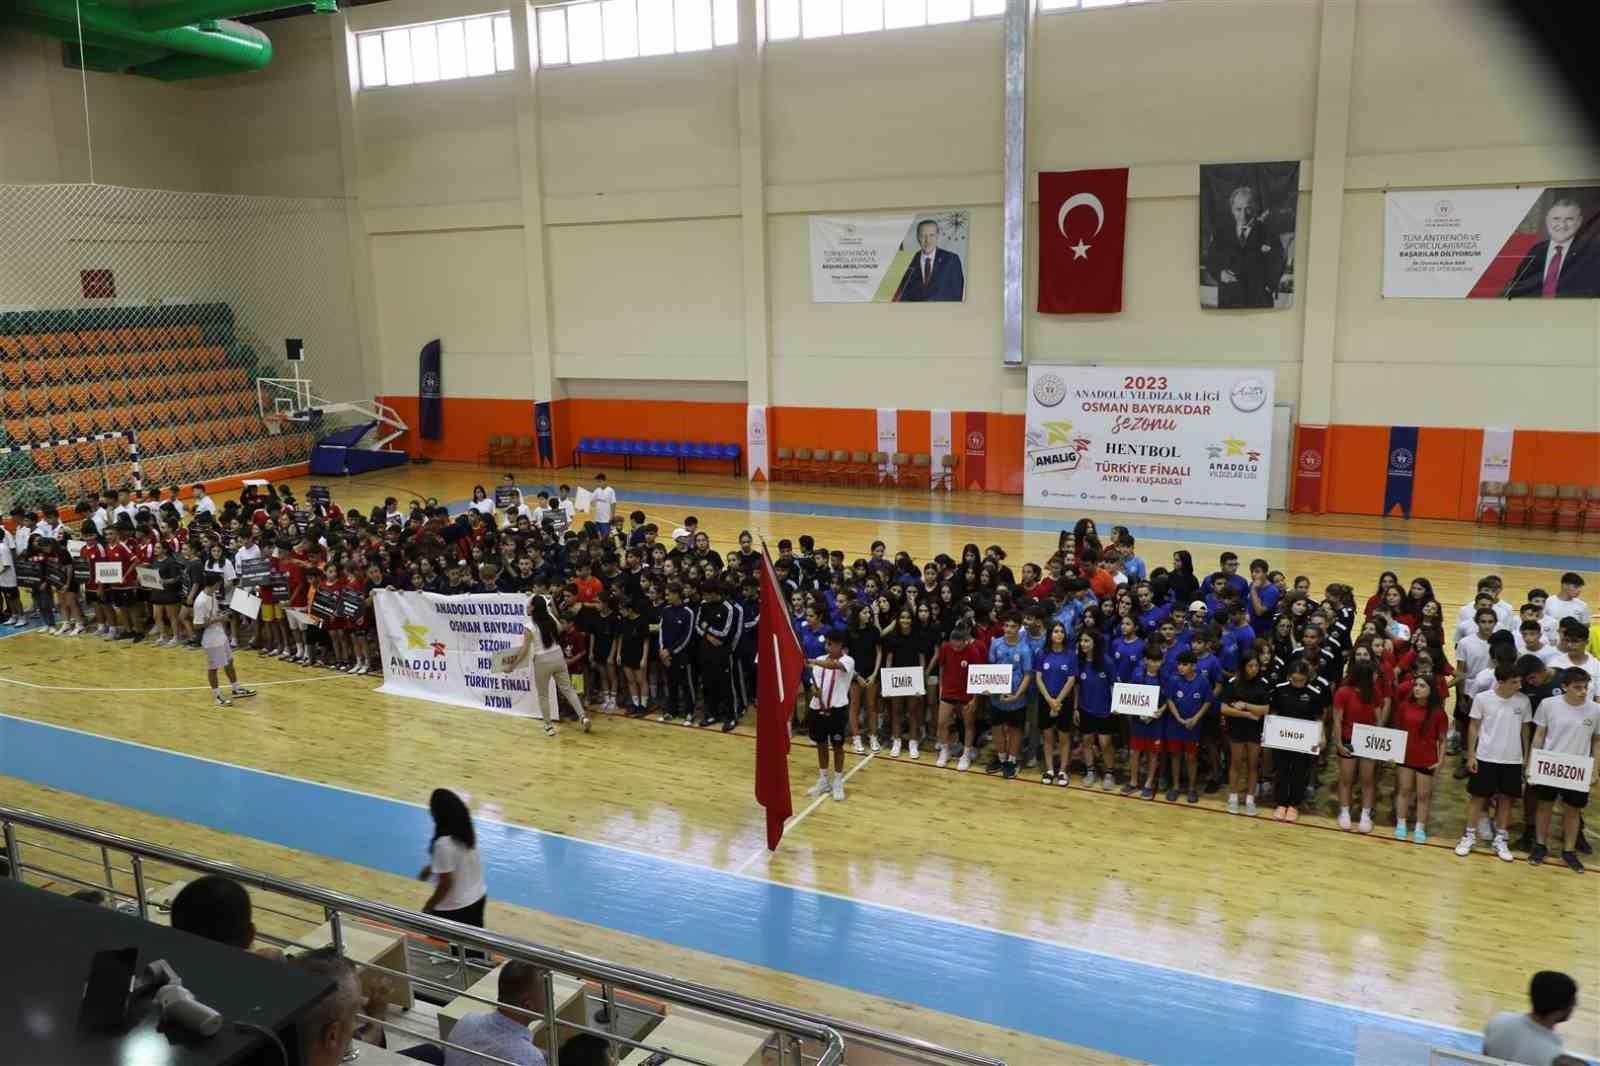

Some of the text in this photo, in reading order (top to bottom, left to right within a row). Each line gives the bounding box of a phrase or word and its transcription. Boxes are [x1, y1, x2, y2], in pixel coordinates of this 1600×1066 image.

[1124, 376, 1168, 390] 2023
[1076, 389, 1125, 400] ANADOLU
[1128, 390, 1192, 401] YILDIZLAR
[1195, 391, 1220, 401] LİGİ
[1081, 402, 1212, 416] OSMAN BAYRAKDAR
[1105, 442, 1181, 459] HENTBOL
[1096, 461, 1147, 475] TÜRKİYE
[1209, 463, 1258, 472] ANADOLU
[1102, 474, 1129, 484] AYDIN
[1136, 476, 1183, 486] KUŞADASI
[435, 603, 476, 616] ANADOLU
[450, 621, 481, 634] OSMAN
[391, 656, 447, 671] ANADOLU
[464, 672, 531, 692] TÜRKİYE FİNALİ
[891, 673, 913, 688] İZMİR
[969, 673, 1010, 686] KASTAMONU
[485, 695, 512, 708] AYDIN
[1119, 691, 1150, 707] MANİSA
[1364, 733, 1392, 751] SİVAS
[1537, 760, 1585, 781] TRABZON
